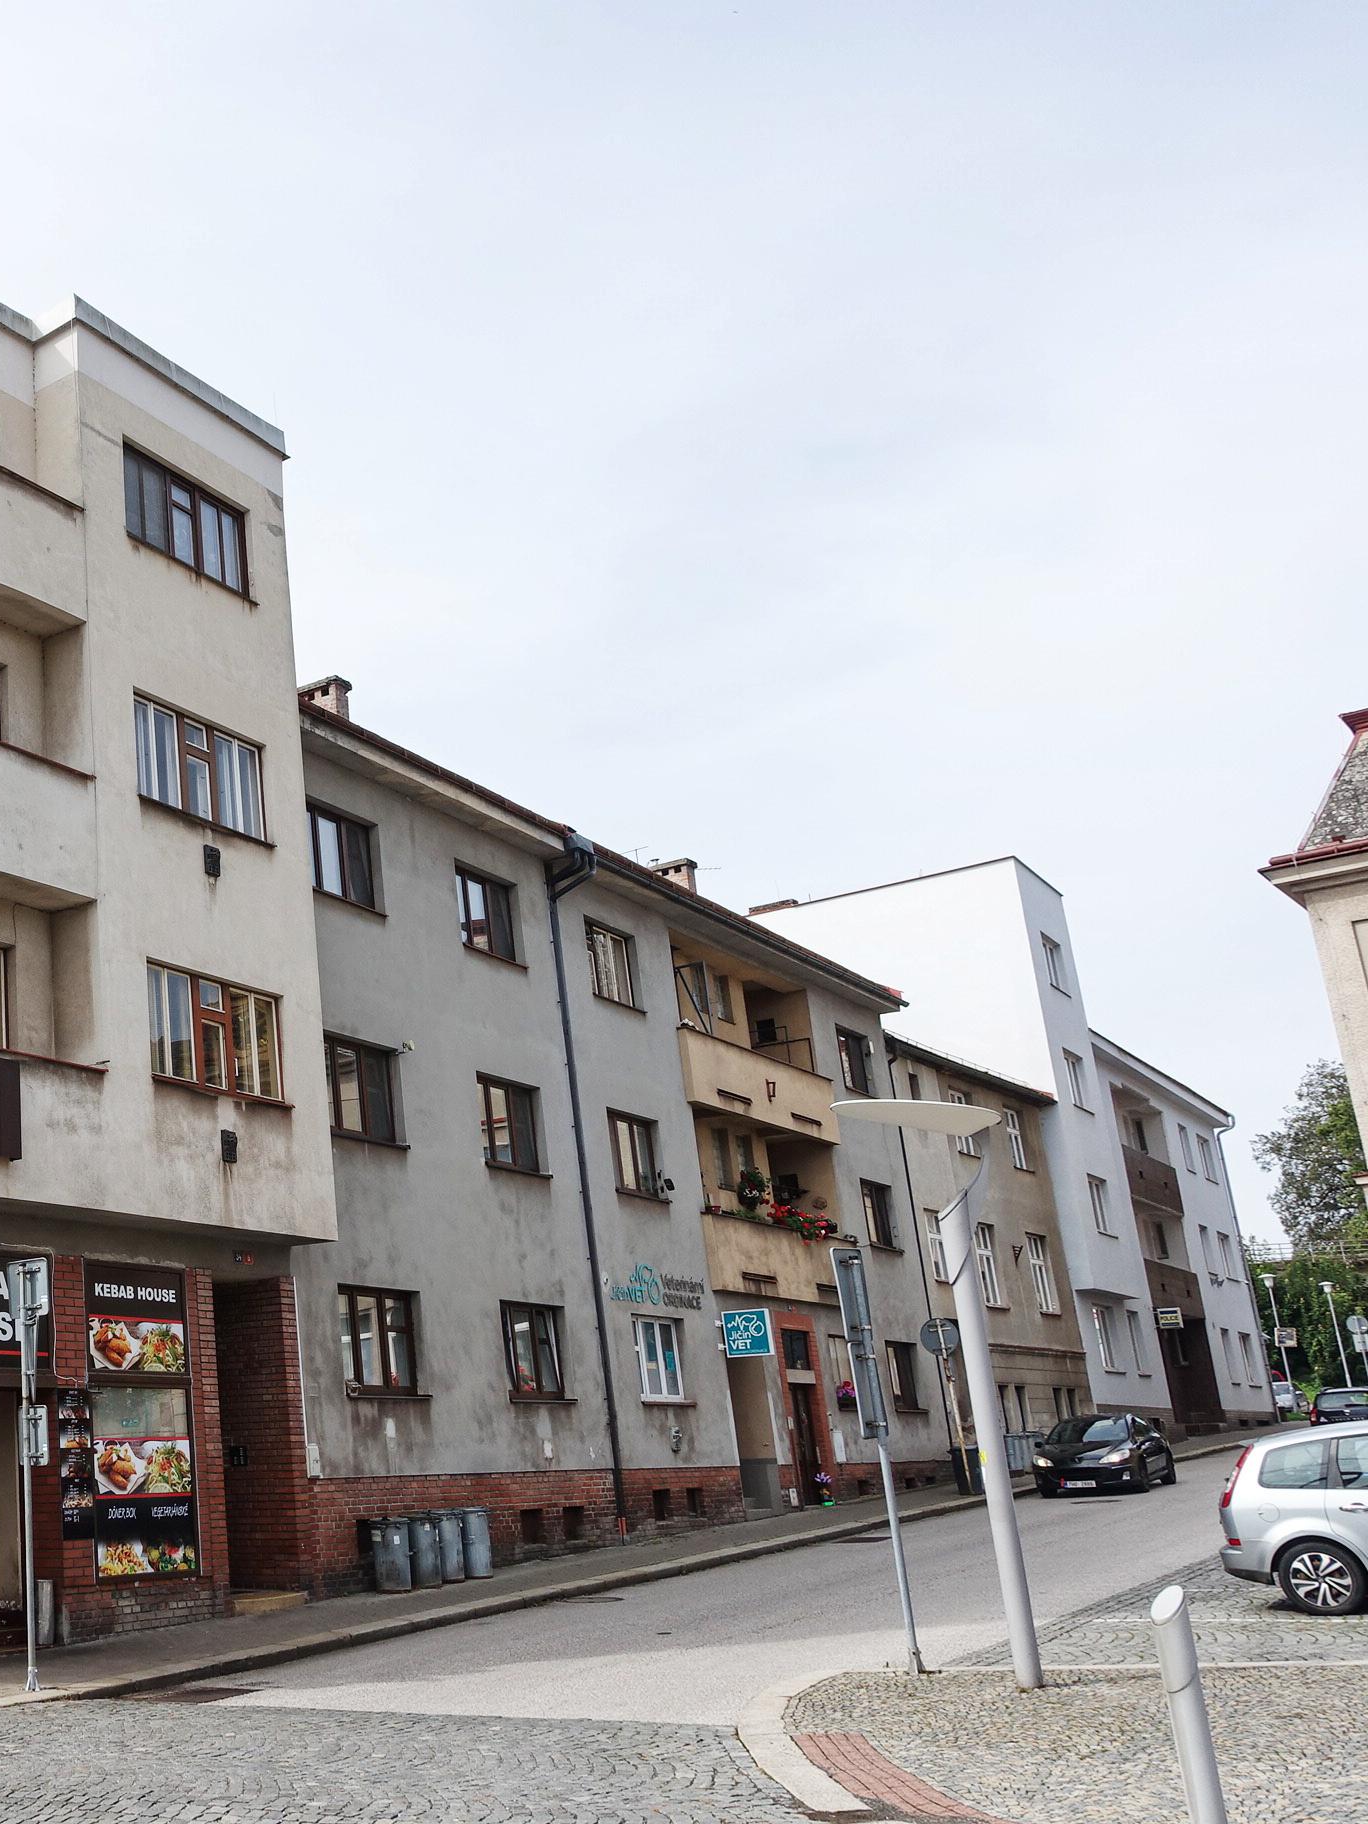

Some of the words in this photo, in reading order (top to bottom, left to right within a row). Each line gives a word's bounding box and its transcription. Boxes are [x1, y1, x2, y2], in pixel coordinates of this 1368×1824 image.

[94, 1282, 135, 1299] KEBAB
[137, 1286, 177, 1303] HOUSE
[729, 1330, 751, 1340] Jičín
[729, 1339, 752, 1350] VET
[125, 1507, 137, 1519] BOX
